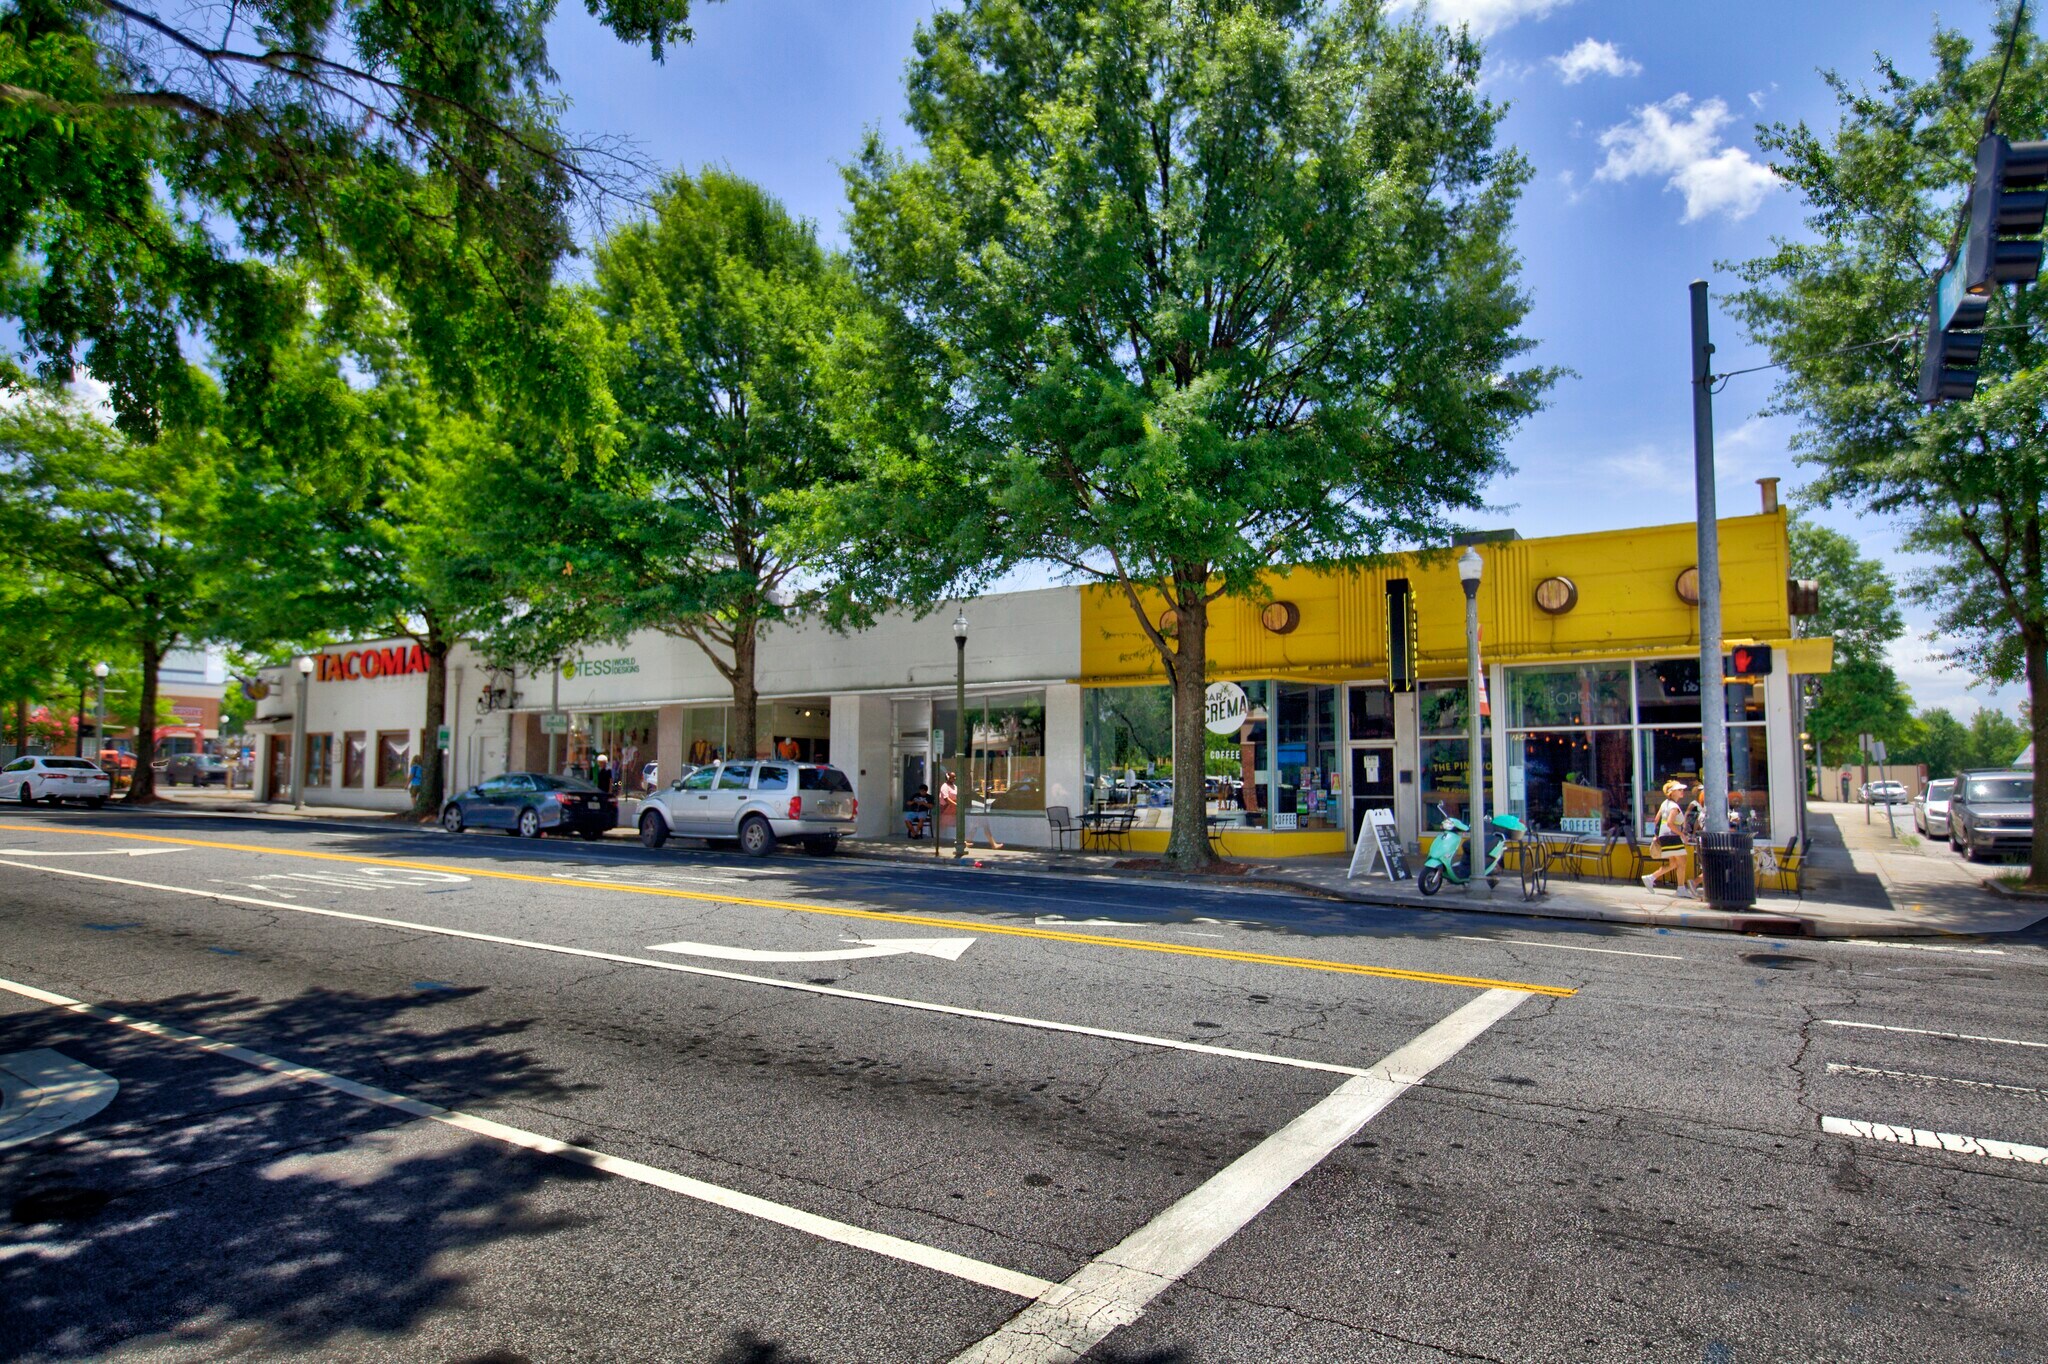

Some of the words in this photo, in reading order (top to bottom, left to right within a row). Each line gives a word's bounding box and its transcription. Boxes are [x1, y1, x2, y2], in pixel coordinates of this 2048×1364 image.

[614, 657, 635, 666] WORLD
[577, 659, 611, 676] TESS
[613, 665, 640, 675] DESIGNS
[1556, 690, 1598, 705] OPEN
[1210, 750, 1241, 760] COFFEE
[1432, 762, 1451, 772] THE
[1215, 799, 1236, 810] EATS
[1274, 814, 1297, 826] COFFEE
[1562, 819, 1600, 832] COFFEE
